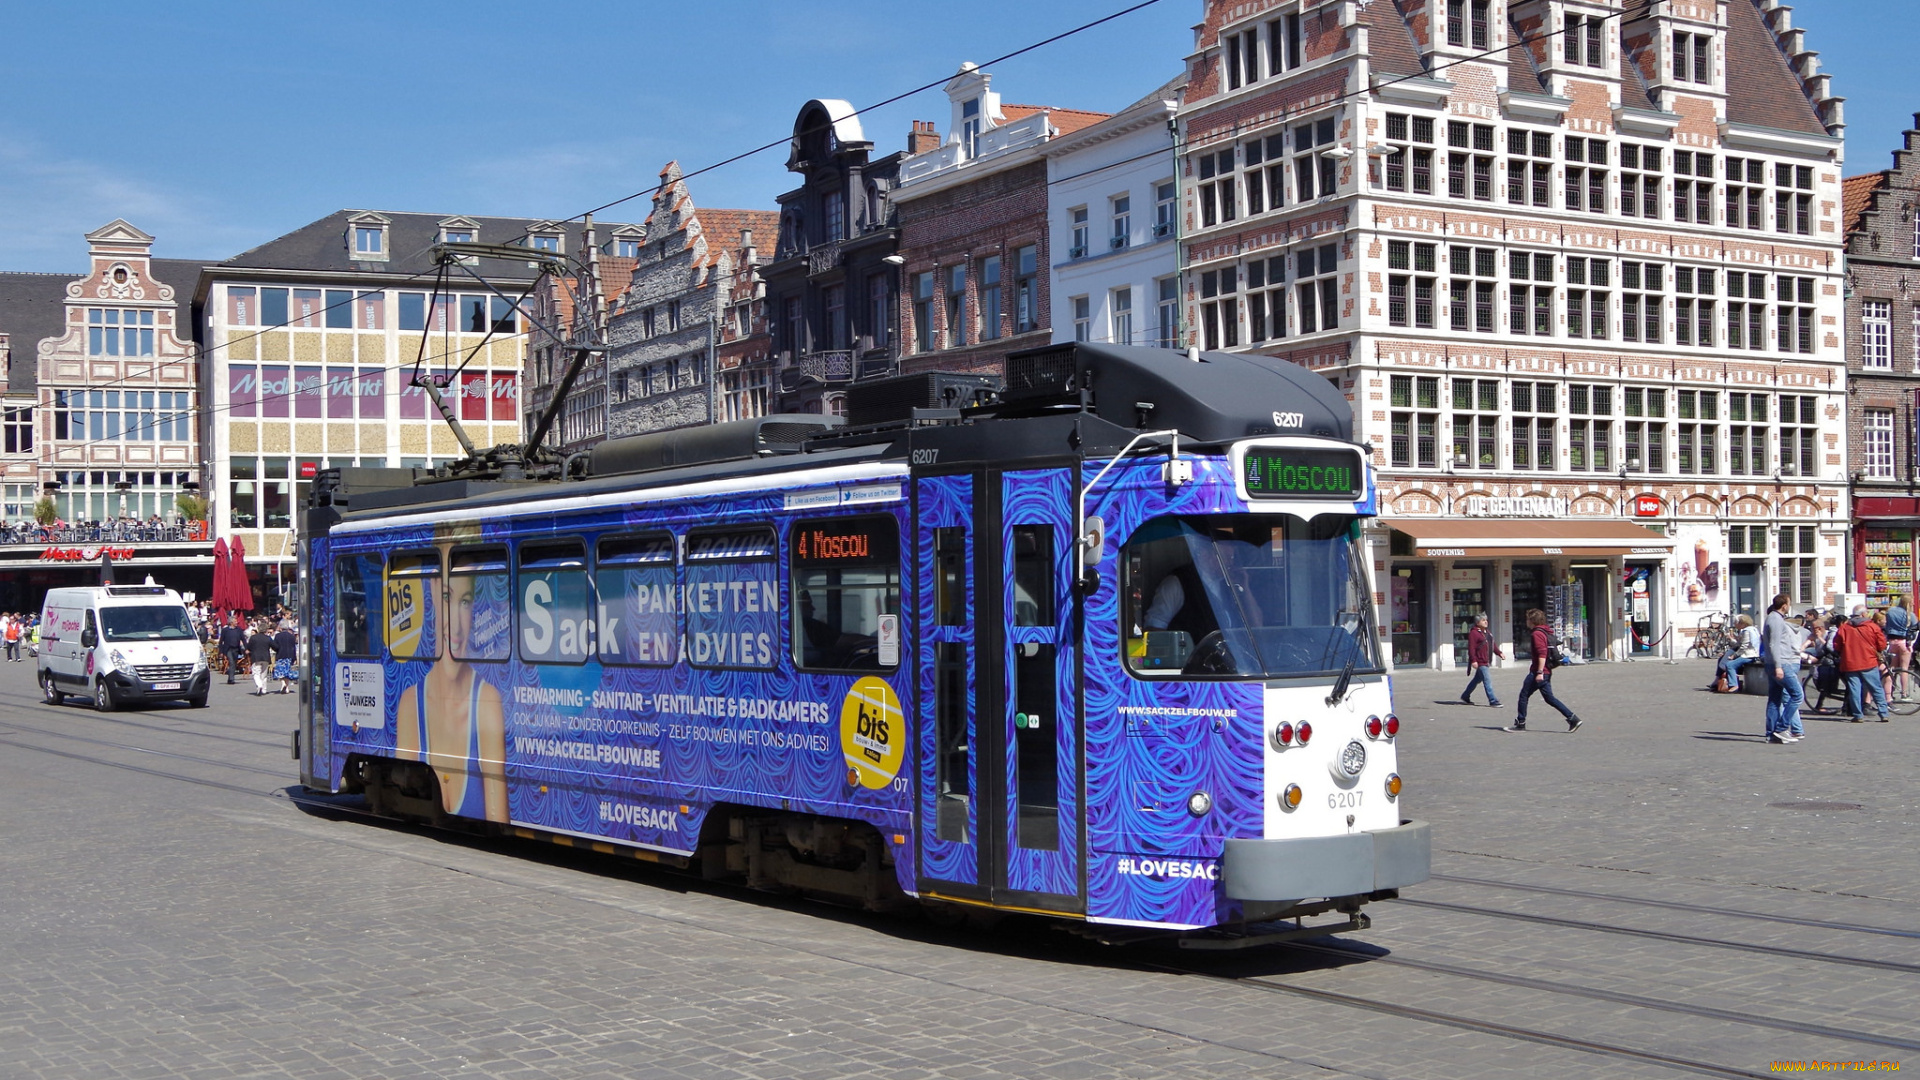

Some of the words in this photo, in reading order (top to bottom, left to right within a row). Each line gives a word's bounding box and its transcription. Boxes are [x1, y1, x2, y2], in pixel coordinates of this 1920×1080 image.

[1272, 411, 1304, 428] 6207
[912, 449, 939, 464] 6207
[1268, 457, 1350, 491] Moscou
[39, 546, 83, 560] Media
[798, 531, 807, 559] 4
[813, 530, 868, 558] Moscou
[1427, 548, 1466, 556] SOUVENIRS
[1543, 547, 1563, 555] PRESS
[389, 580, 413, 617] bis
[638, 580, 779, 614] PAKKETTEN
[523, 578, 621, 656] Sack
[639, 632, 668, 662] EN
[677, 632, 772, 665] ADVIES
[350, 695, 376, 707] JUNKERS
[514, 686, 583, 708] VERWARMING
[592, 690, 643, 712] SANITAIR
[653, 693, 726, 717] VENTILATIE
[727, 698, 738, 717] &
[739, 698, 829, 724] BADKAMERS
[1117, 706, 1237, 717] WWW.SACKZELFBOUW.BE
[514, 712, 531, 726] OOK
[544, 716, 561, 729] KAN
[568, 716, 602, 732] ZONDER
[604, 719, 660, 737] VOORKENNIS
[669, 724, 692, 739] ZELF
[694, 727, 737, 744] BOUWEN
[741, 731, 760, 745] MET
[761, 732, 785, 747] ONS
[786, 733, 829, 751] ADVIES!
[856, 702, 890, 745] bis
[514, 737, 660, 769] WWW.SACKZELFBOUW.BE
[893, 777, 909, 793] 07
[1328, 790, 1364, 809] 6207
[600, 801, 679, 832] #LOVESACK
